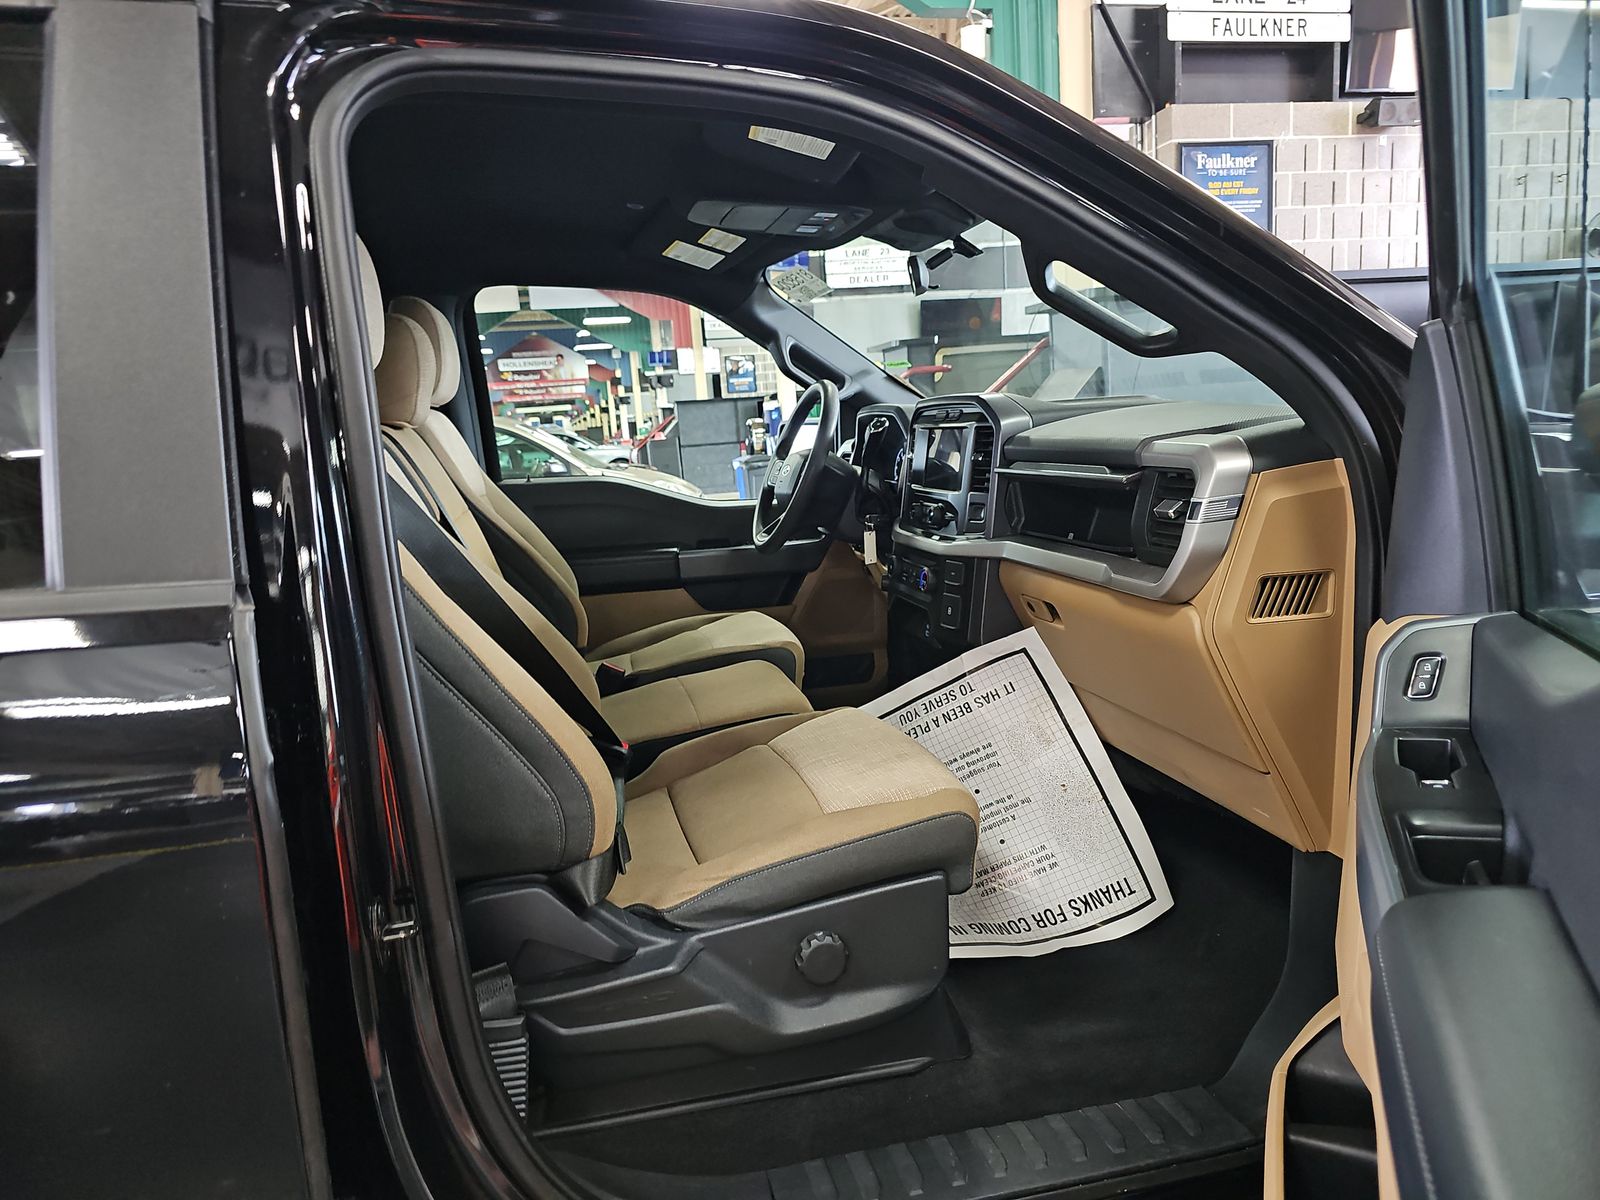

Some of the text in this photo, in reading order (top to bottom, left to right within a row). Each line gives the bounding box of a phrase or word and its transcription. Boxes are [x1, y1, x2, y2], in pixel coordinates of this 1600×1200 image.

[1212, 17, 1308, 37] FAULKNER
[1196, 153, 1258, 169] Faulkner
[1208, 169, 1218, 177] TO
[1230, 168, 1247, 176] SURE
[845, 249, 870, 257] LANE
[849, 275, 889, 284] DEALER
[1003, 681, 1016, 696] IT
[898, 681, 976, 726] TO SERVE YOU
[973, 688, 1001, 708] HAS
[942, 701, 973, 724] BEEN
[931, 716, 940, 728] A
[982, 742, 992, 751] are
[959, 746, 980, 761] always
[956, 750, 998, 773] improving our
[986, 760, 1002, 771] Your
[996, 797, 1006, 806] the
[1002, 801, 1020, 813] most
[1020, 796, 1032, 806] the
[974, 844, 1048, 879] WITH THIS PAPER MAT
[1048, 861, 1060, 871] WE
[974, 852, 1056, 889] YOUR CARPETING CLEAN
[1030, 867, 1047, 878] HAVE
[980, 886, 998, 898] KEEP
[950, 877, 1136, 936] THANKS FOR COMING IN
